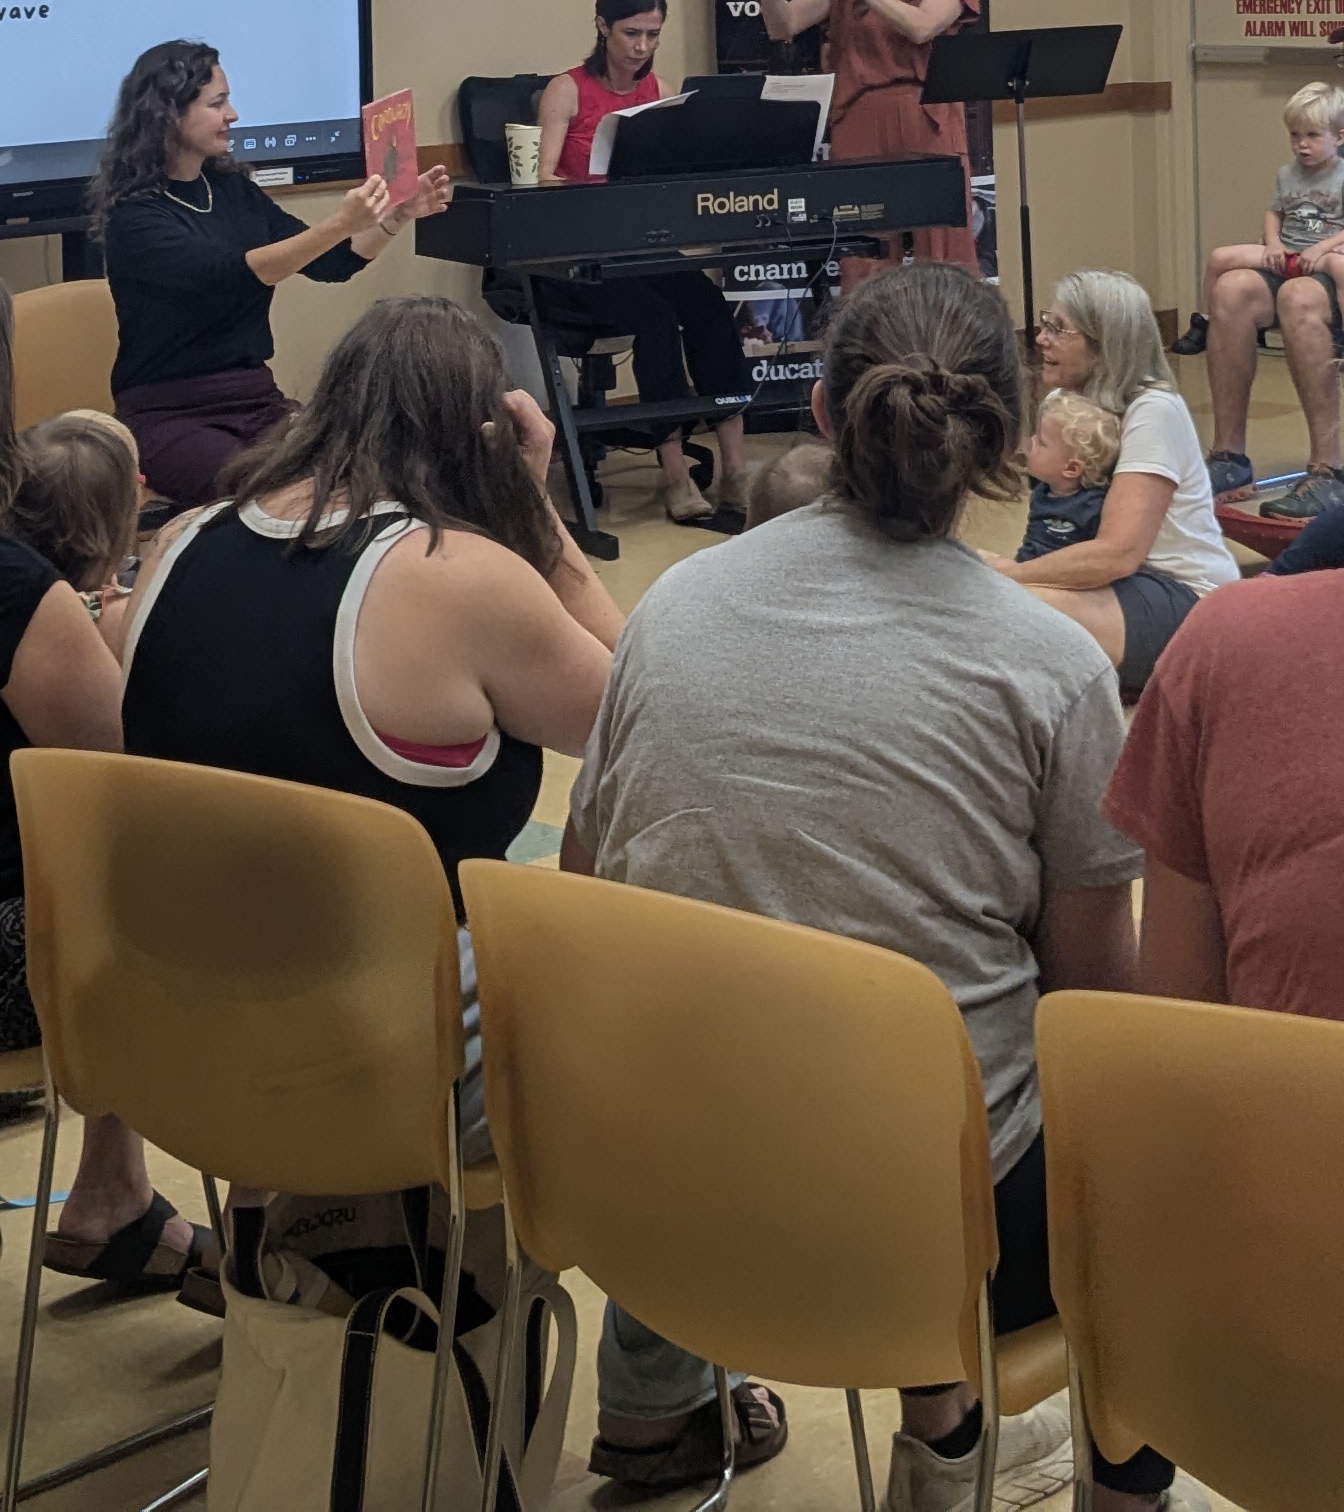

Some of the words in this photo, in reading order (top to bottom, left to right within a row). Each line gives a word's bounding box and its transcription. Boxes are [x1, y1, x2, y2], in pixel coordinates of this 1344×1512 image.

[1244, 20, 1286, 37] ALARM
[1288, 21, 1317, 37] WILL
[697, 188, 779, 216] Roland
